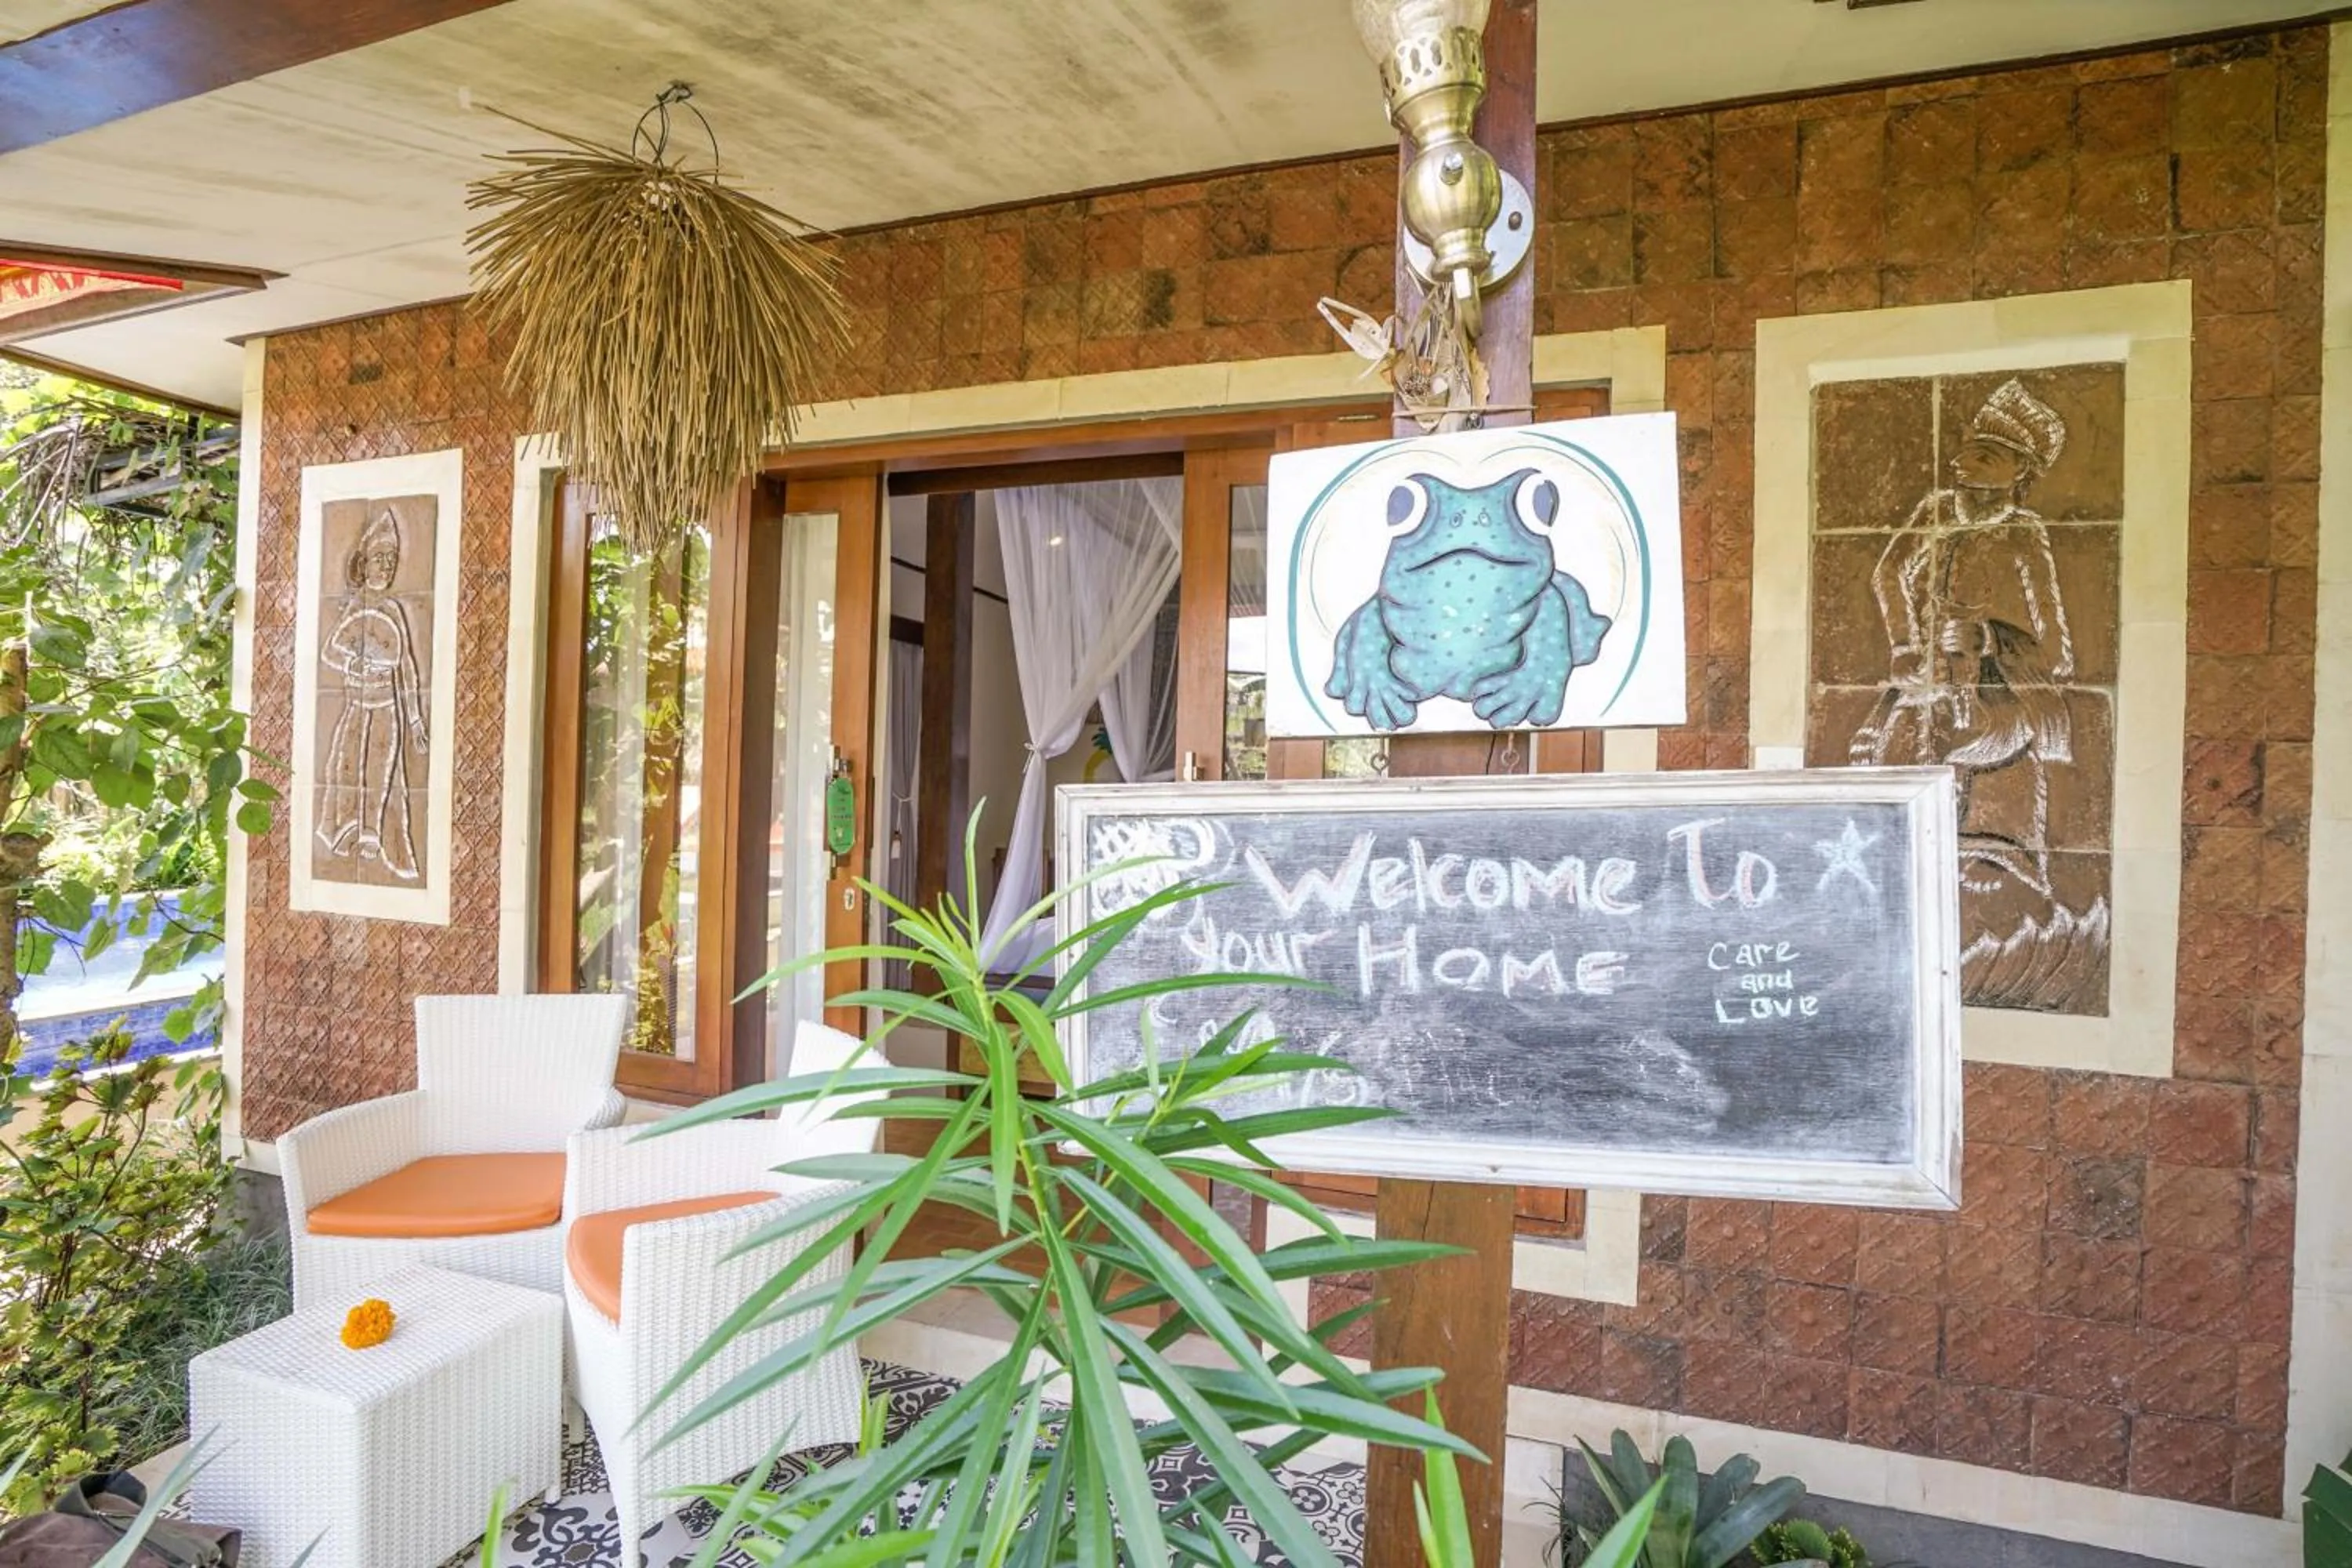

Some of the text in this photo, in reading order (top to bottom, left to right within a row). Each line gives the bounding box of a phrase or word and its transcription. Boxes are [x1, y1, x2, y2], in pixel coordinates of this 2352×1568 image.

[1243, 817, 1777, 917] Welcome To
[1707, 941, 1801, 971] Care
[1740, 969, 1794, 993] and
[1715, 996, 1820, 1023] Love
